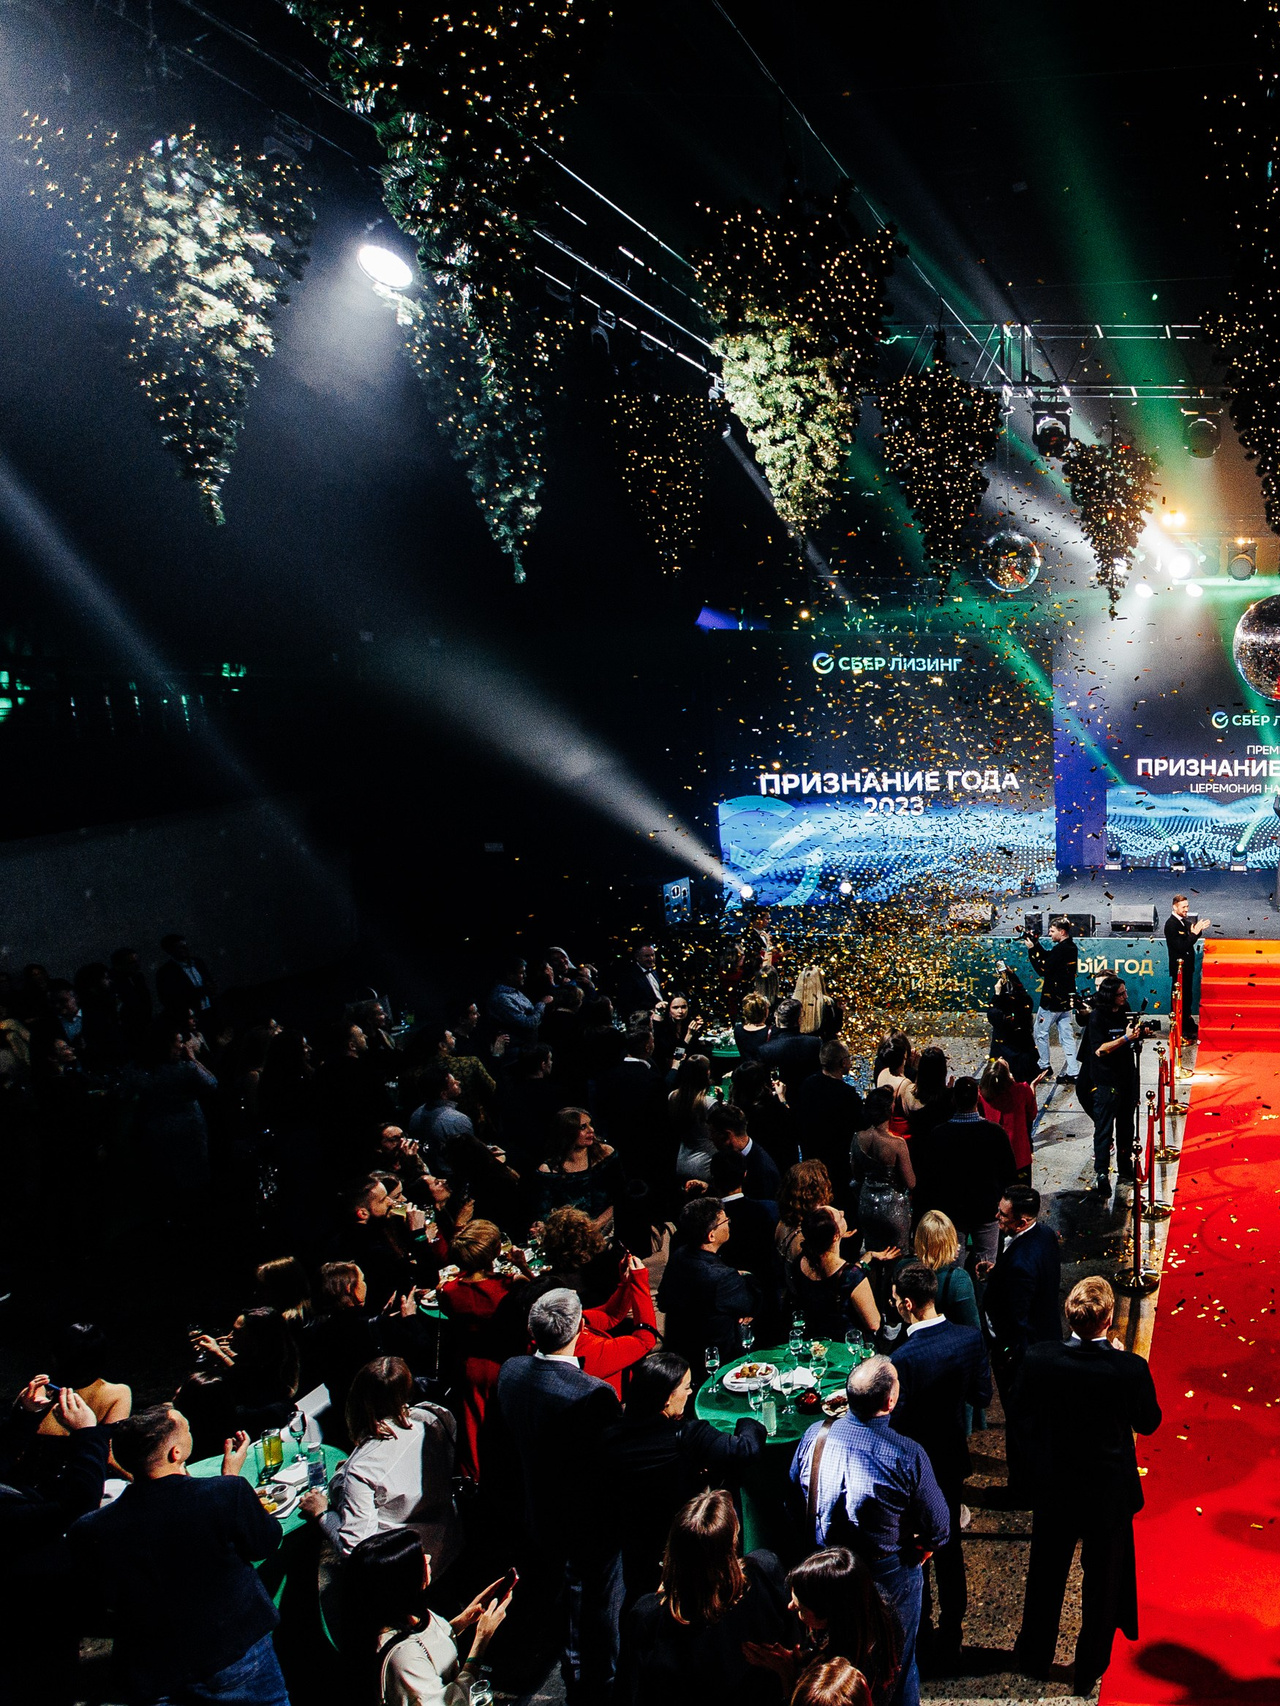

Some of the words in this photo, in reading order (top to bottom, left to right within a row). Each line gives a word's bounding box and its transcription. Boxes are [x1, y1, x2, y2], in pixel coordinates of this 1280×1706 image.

[838, 656, 886, 671] СБЕР
[890, 657, 962, 672] ЛИЗИНГ
[1232, 714, 1270, 726] СБЕР
[1137, 759, 1280, 777] ПРИЗНАНИЕ
[759, 772, 939, 795] ПРИЗНАНИЕ
[948, 770, 1020, 793] ГОДА
[1190, 783, 1262, 794] ЦЕРЕМОНИЯ
[864, 796, 924, 817] 2023
[1077, 955, 1108, 973] ЫЙ
[1114, 959, 1154, 976] ГОД
